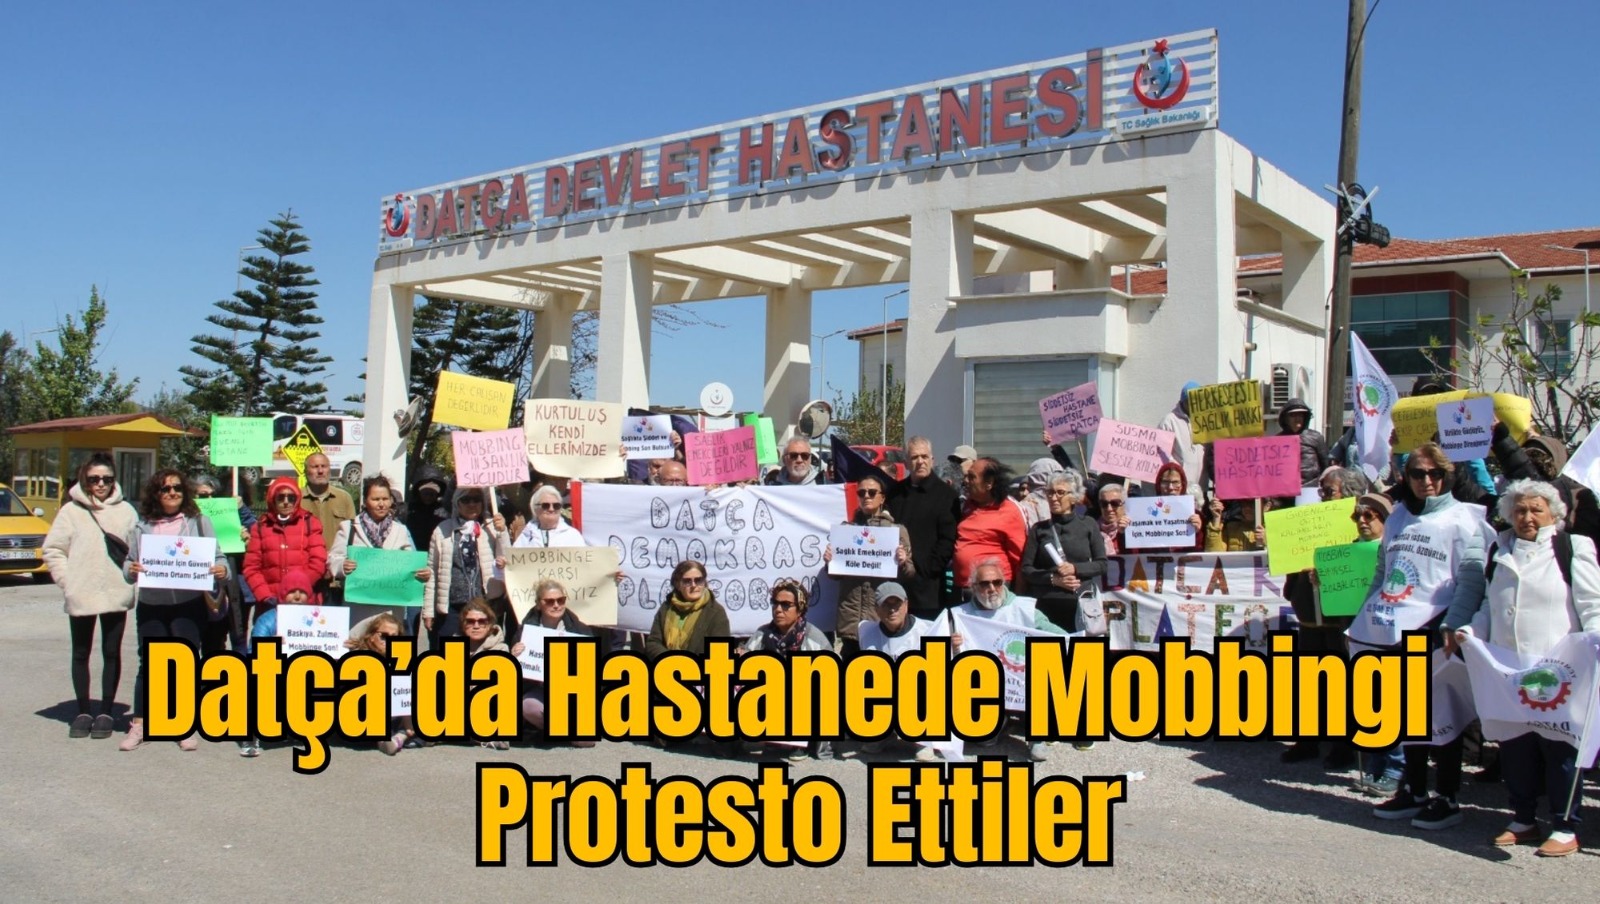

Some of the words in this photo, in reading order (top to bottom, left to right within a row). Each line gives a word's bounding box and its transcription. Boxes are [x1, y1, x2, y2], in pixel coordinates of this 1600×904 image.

[1122, 121, 1132, 129] TC
[415, 174, 531, 241] DATÇA
[543, 133, 722, 219] DEVLET
[738, 48, 1104, 185] HASTANESİ
[535, 404, 607, 425] KURTULUŞ
[549, 424, 584, 439] KENDİ
[1115, 424, 1157, 442] SUSMA
[459, 435, 521, 456] MOBBING
[527, 440, 607, 456] ELLERİMİZDE
[1218, 462, 1284, 479] HASTANE
[650, 497, 774, 534] DATÇA
[511, 549, 593, 565] MOBBİNGE
[836, 547, 856, 555] Sağlık
[857, 549, 892, 557] Emekçileri
[175, 559, 187, 567] İçin
[845, 560, 860, 568] Köle
[862, 561, 882, 569] Değil!
[317, 630, 340, 638] Zulme,
